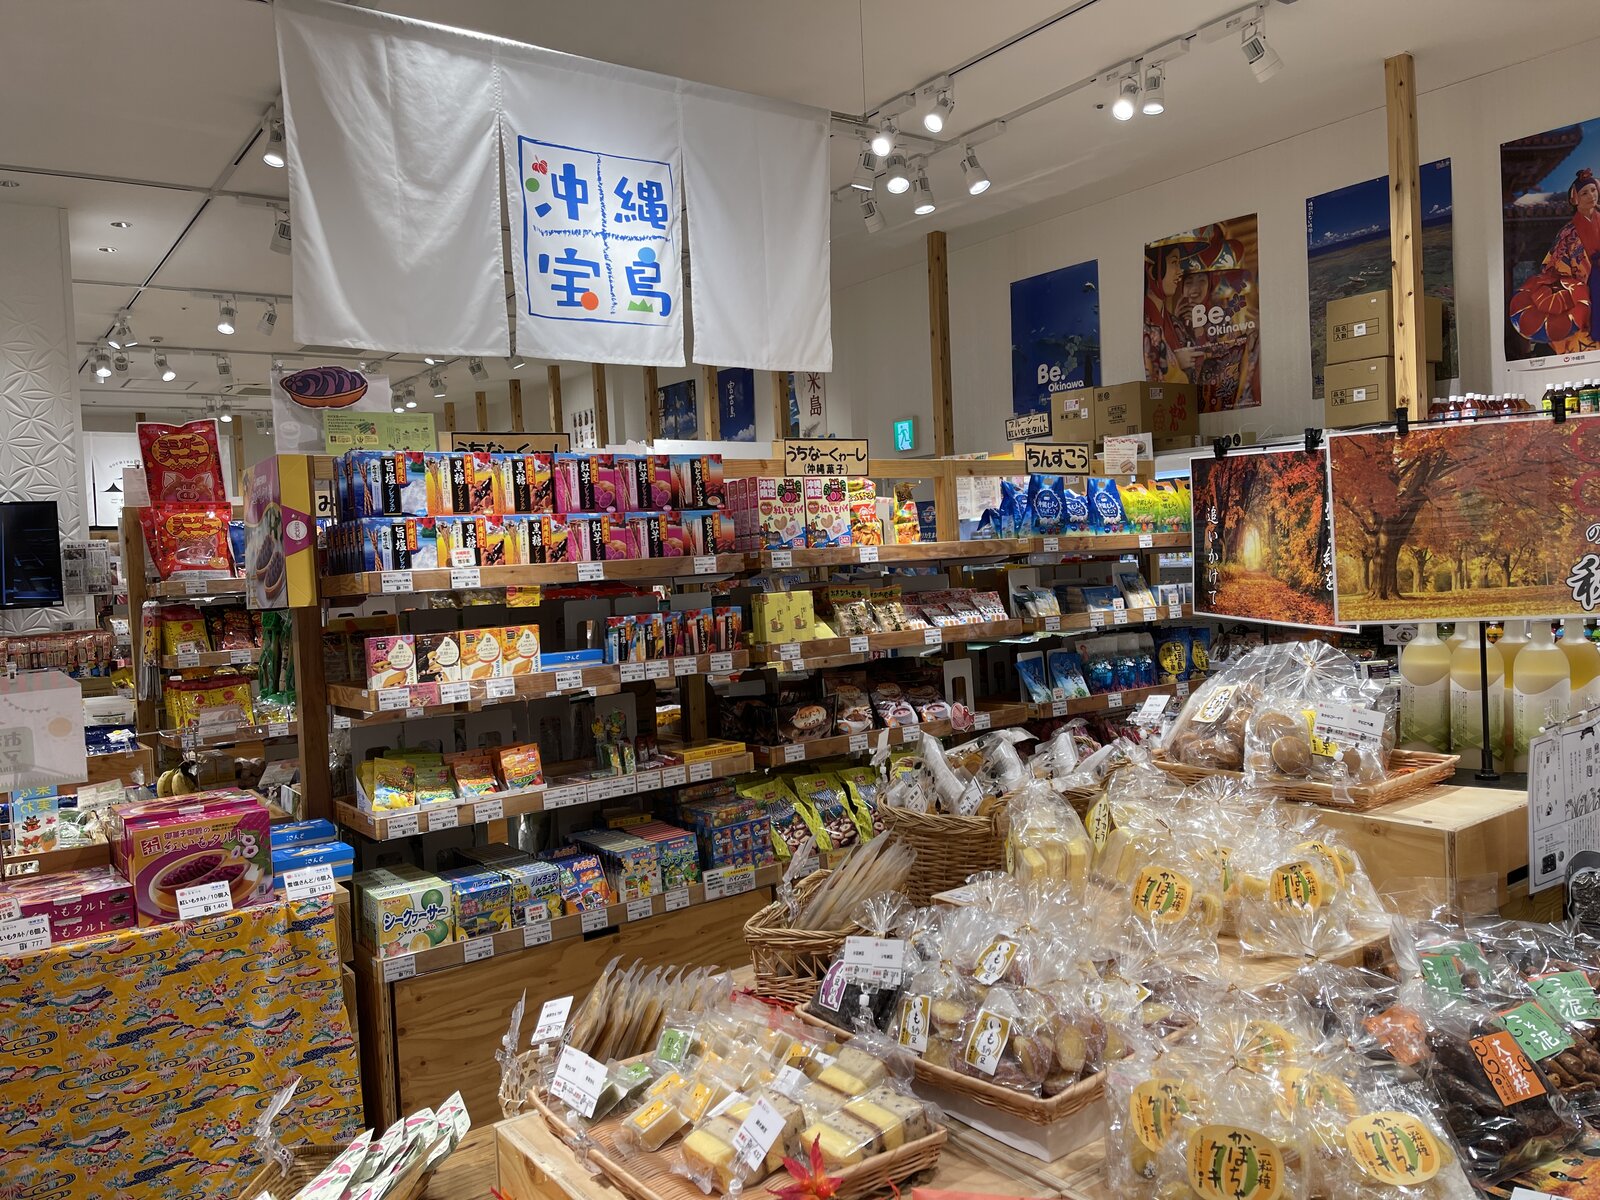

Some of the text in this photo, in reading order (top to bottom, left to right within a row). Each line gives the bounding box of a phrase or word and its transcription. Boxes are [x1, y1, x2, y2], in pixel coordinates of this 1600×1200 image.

[525, 156, 669, 230] 沖縄
[538, 246, 673, 317] 宝島
[1192, 304, 1231, 328] Be.
[1207, 320, 1256, 336] Okinawa
[1037, 364, 1065, 384] Be.
[1048, 379, 1084, 392] Okinawa
[1027, 448, 1088, 469] ちんすこう
[1207, 506, 1219, 605] 追いかけて
[1364, 1131, 1392, 1173] ケーキ
[1371, 1117, 1416, 1178] かぼちゃ
[1406, 1125, 1430, 1158] 一粒種
[1208, 1142, 1227, 1189] ケーキ
[1257, 1152, 1275, 1190] 一粒種
